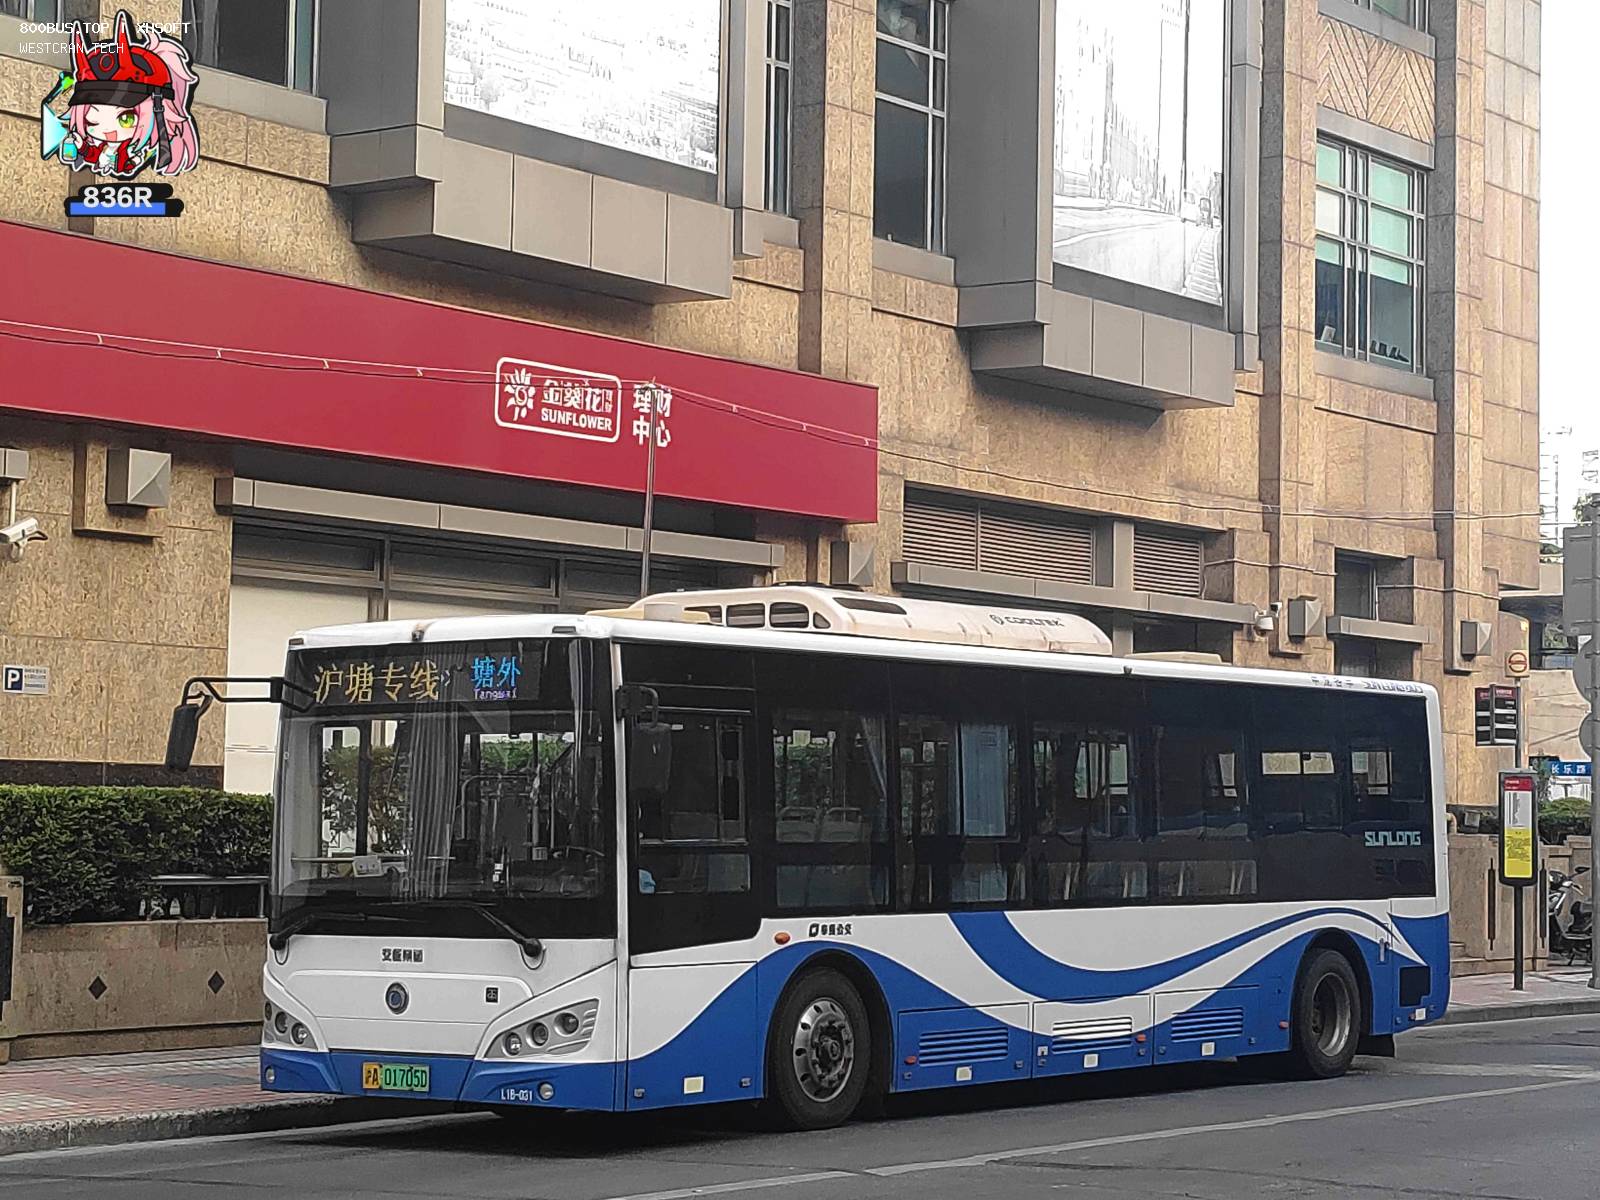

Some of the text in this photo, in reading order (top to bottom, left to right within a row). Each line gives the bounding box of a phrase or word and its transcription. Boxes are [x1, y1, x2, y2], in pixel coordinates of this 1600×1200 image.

[541, 407, 613, 432] SUNFLOWER
[633, 414, 672, 448] 中心
[7, 669, 20, 689] P
[314, 659, 441, 705] 沪塘专线
[471, 656, 521, 687] 塘外
[1364, 831, 1422, 847] SUNLONG
